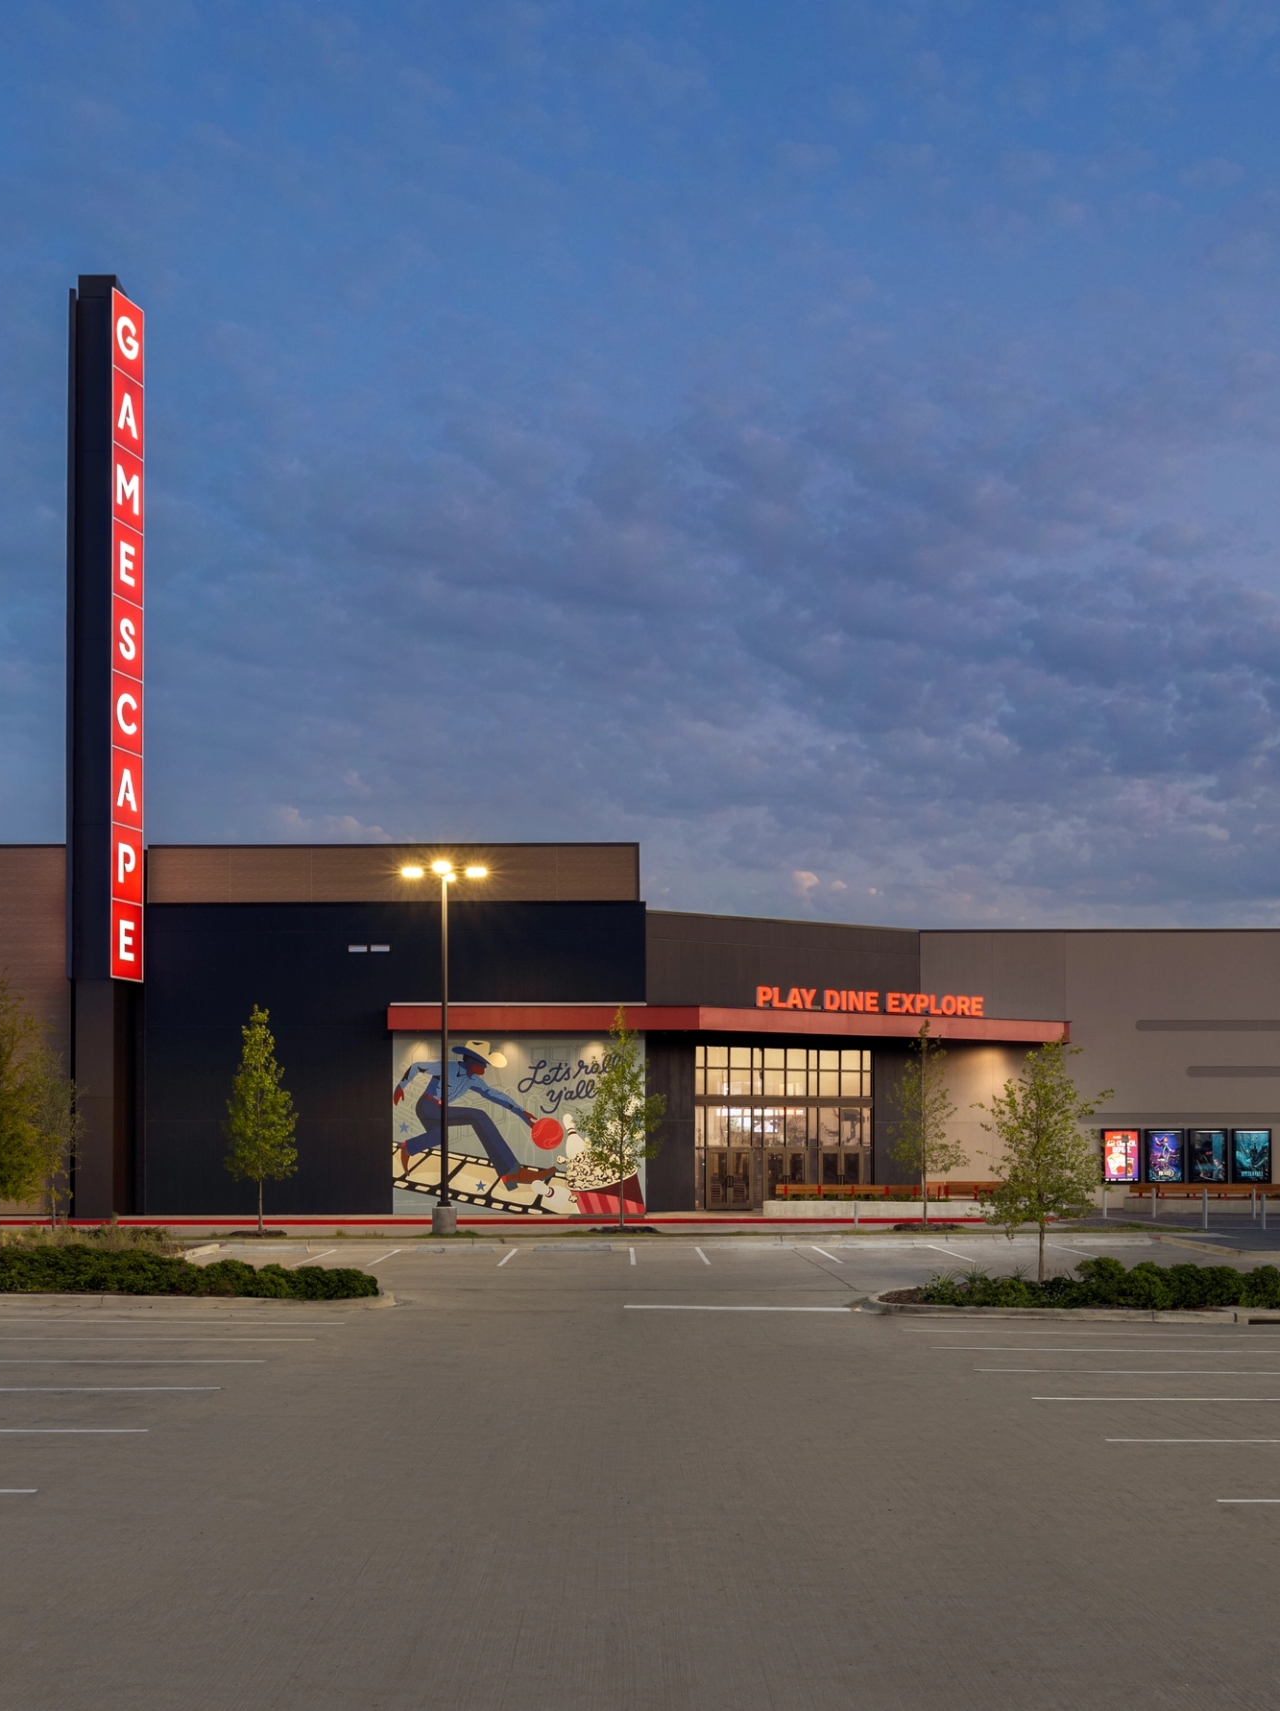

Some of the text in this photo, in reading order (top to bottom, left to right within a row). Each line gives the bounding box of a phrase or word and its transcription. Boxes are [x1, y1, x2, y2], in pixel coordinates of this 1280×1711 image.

[116, 315, 140, 962] GAMESCAPE
[756, 985, 984, 1017] PLAY DINE EXPLORE
[517, 1060, 571, 1093] Let's
[540, 1079, 598, 1114] y'all
